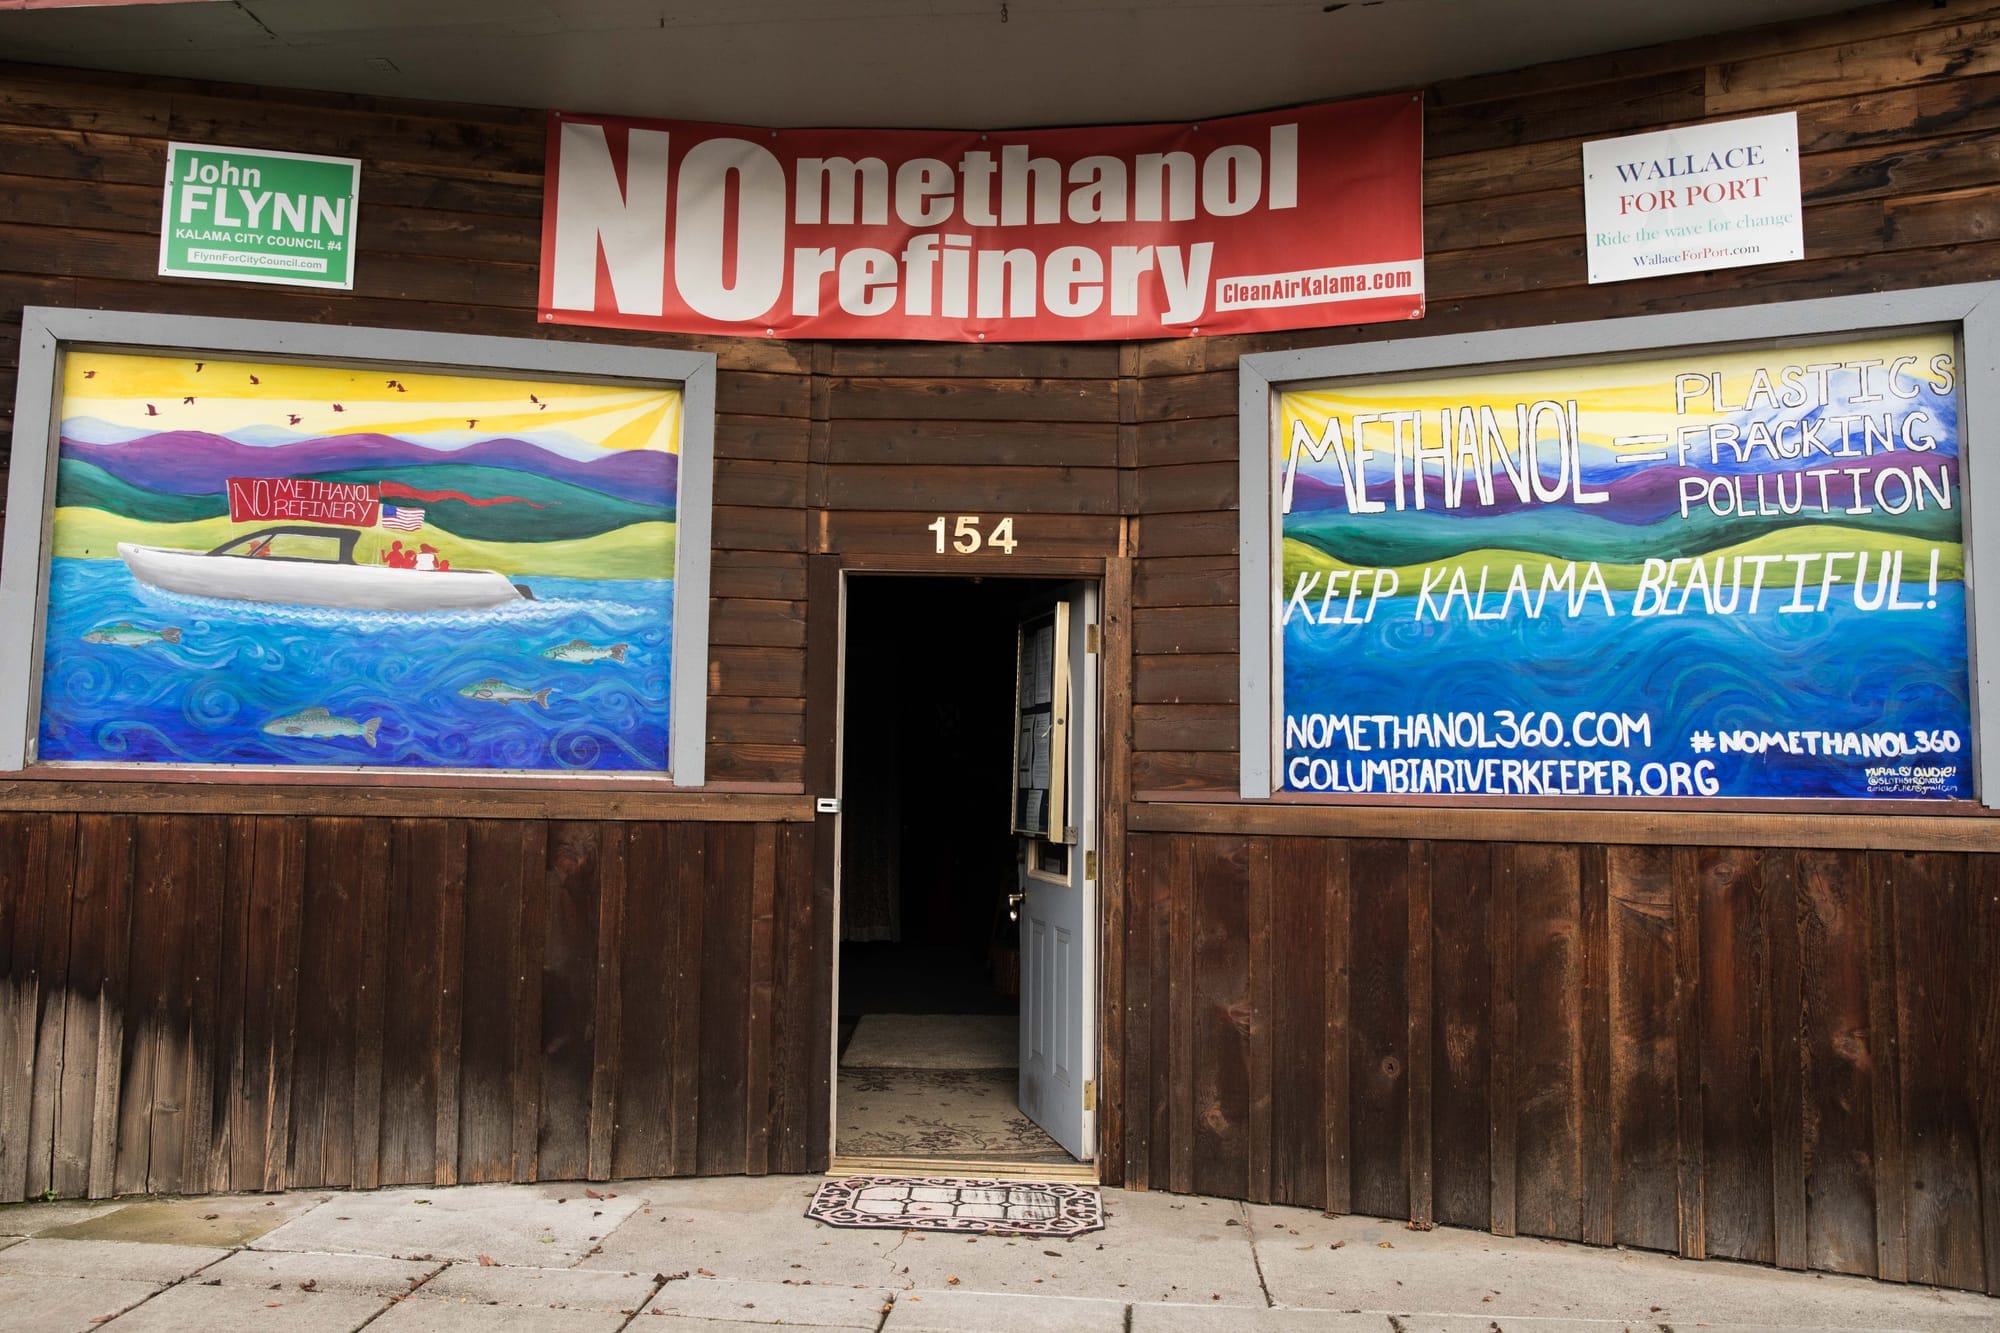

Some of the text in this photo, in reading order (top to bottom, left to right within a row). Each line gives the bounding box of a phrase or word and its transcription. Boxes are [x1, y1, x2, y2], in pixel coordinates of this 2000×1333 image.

[183, 157, 261, 188] John
[1616, 145, 1765, 183] WALLACE
[180, 185, 346, 236] FLYNN
[1619, 176, 1768, 215] FOR PORT
[176, 228, 342, 251] KALAMA CITY COUNCIL #4
[552, 122, 1299, 321] NO methanol
[1596, 211, 1793, 247] Ride the wave for change
[193, 251, 322, 270] FlynnForCityCouncil.com
[1633, 243, 1760, 267] WallaceForPort.com
[792, 234, 1214, 325] refinery
[1223, 269, 1412, 304] CleanAirKalama.com
[1675, 354, 1955, 415] PLASTICS
[1282, 400, 1609, 514] METHANOL
[1676, 411, 1937, 467] FRACKING
[233, 479, 378, 517] NO METHANOL
[274, 498, 372, 522] REFINERY
[1678, 465, 1953, 519] POLLUTION
[928, 516, 1018, 554] 154
[1283, 549, 1940, 625] KEEP KALAMA BEAUTIFUL!
[1285, 710, 1651, 752] NOMETHANOL360.COM
[1690, 730, 1960, 757] #NOMETHANOL360
[1287, 757, 1720, 796] COLUMBIARIVERKEEPER.ORG
[1865, 766, 1899, 777] MURAL
